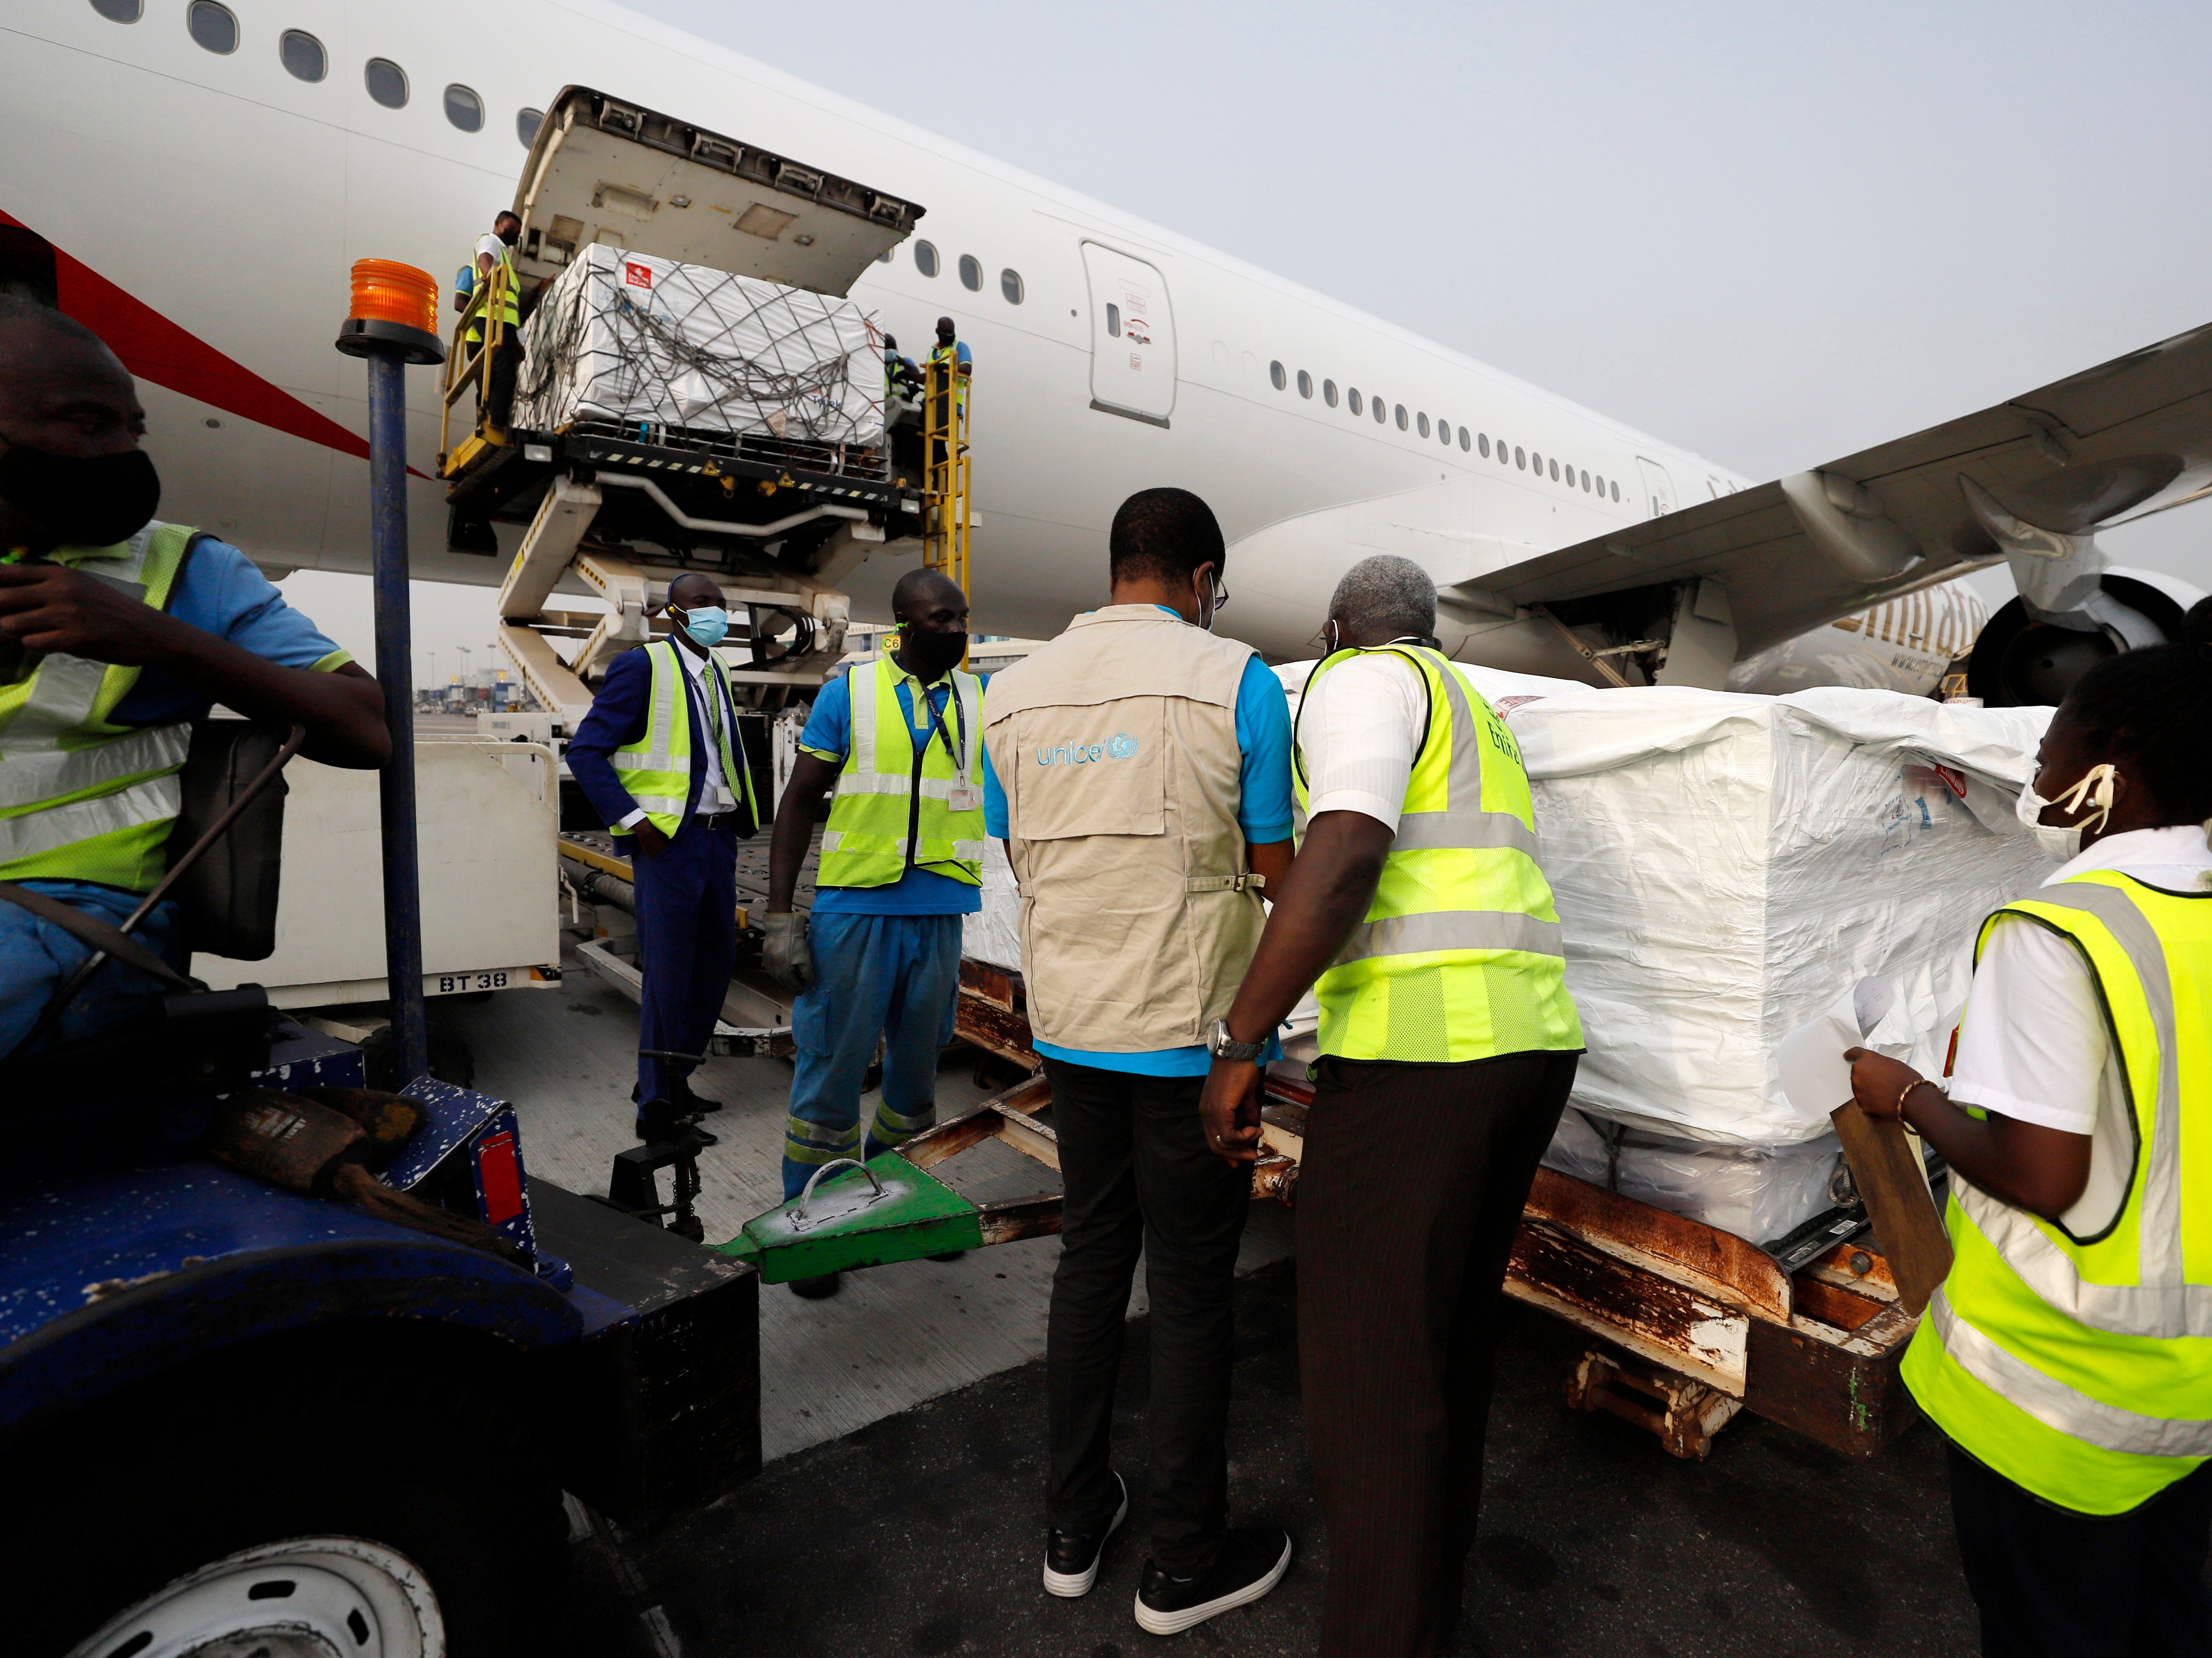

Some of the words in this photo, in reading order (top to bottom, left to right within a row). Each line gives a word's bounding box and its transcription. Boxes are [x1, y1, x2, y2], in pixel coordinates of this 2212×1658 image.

[628, 273, 649, 283] Emirtes
[1832, 581, 1991, 660] mirate
[884, 638, 899, 648] C6
[440, 975, 471, 992] BT
[477, 972, 507, 989] 38
